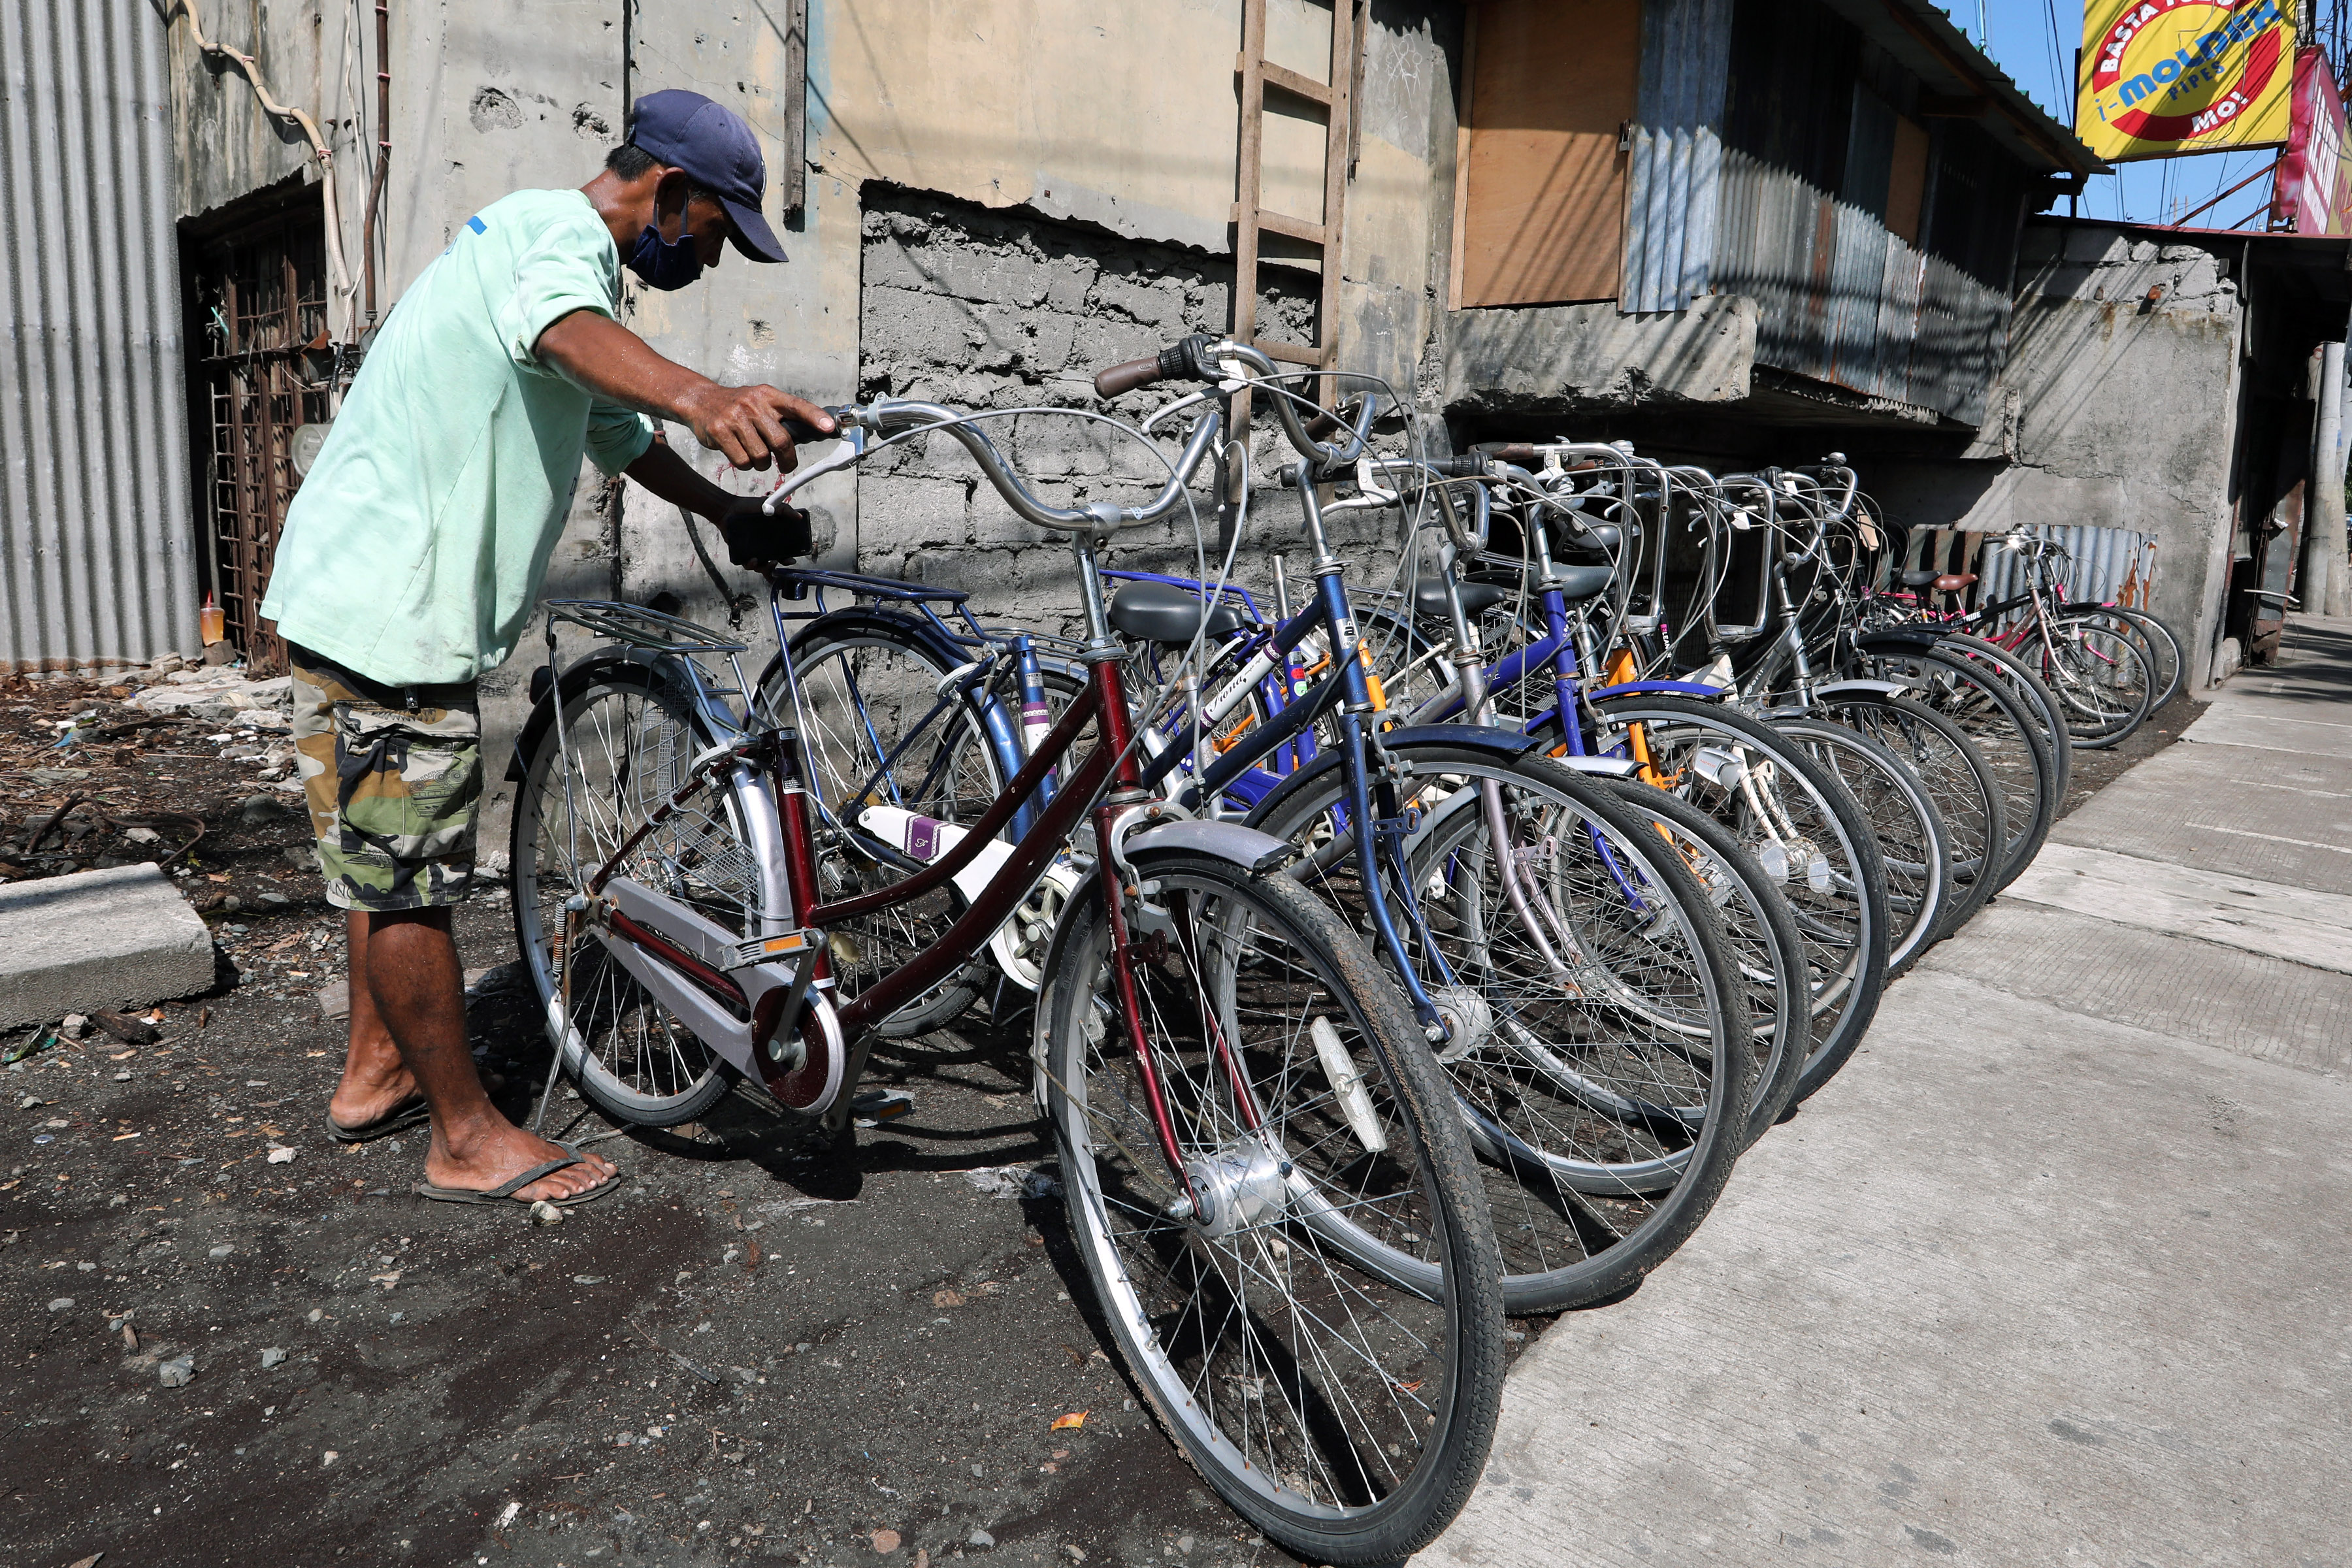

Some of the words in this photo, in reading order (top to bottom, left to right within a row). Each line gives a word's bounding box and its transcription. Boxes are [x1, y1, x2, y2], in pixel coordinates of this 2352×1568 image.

[2100, 3, 2159, 72] BASTA
[2168, 61, 2225, 101] PIPES
[2191, 91, 2249, 133] MO!
